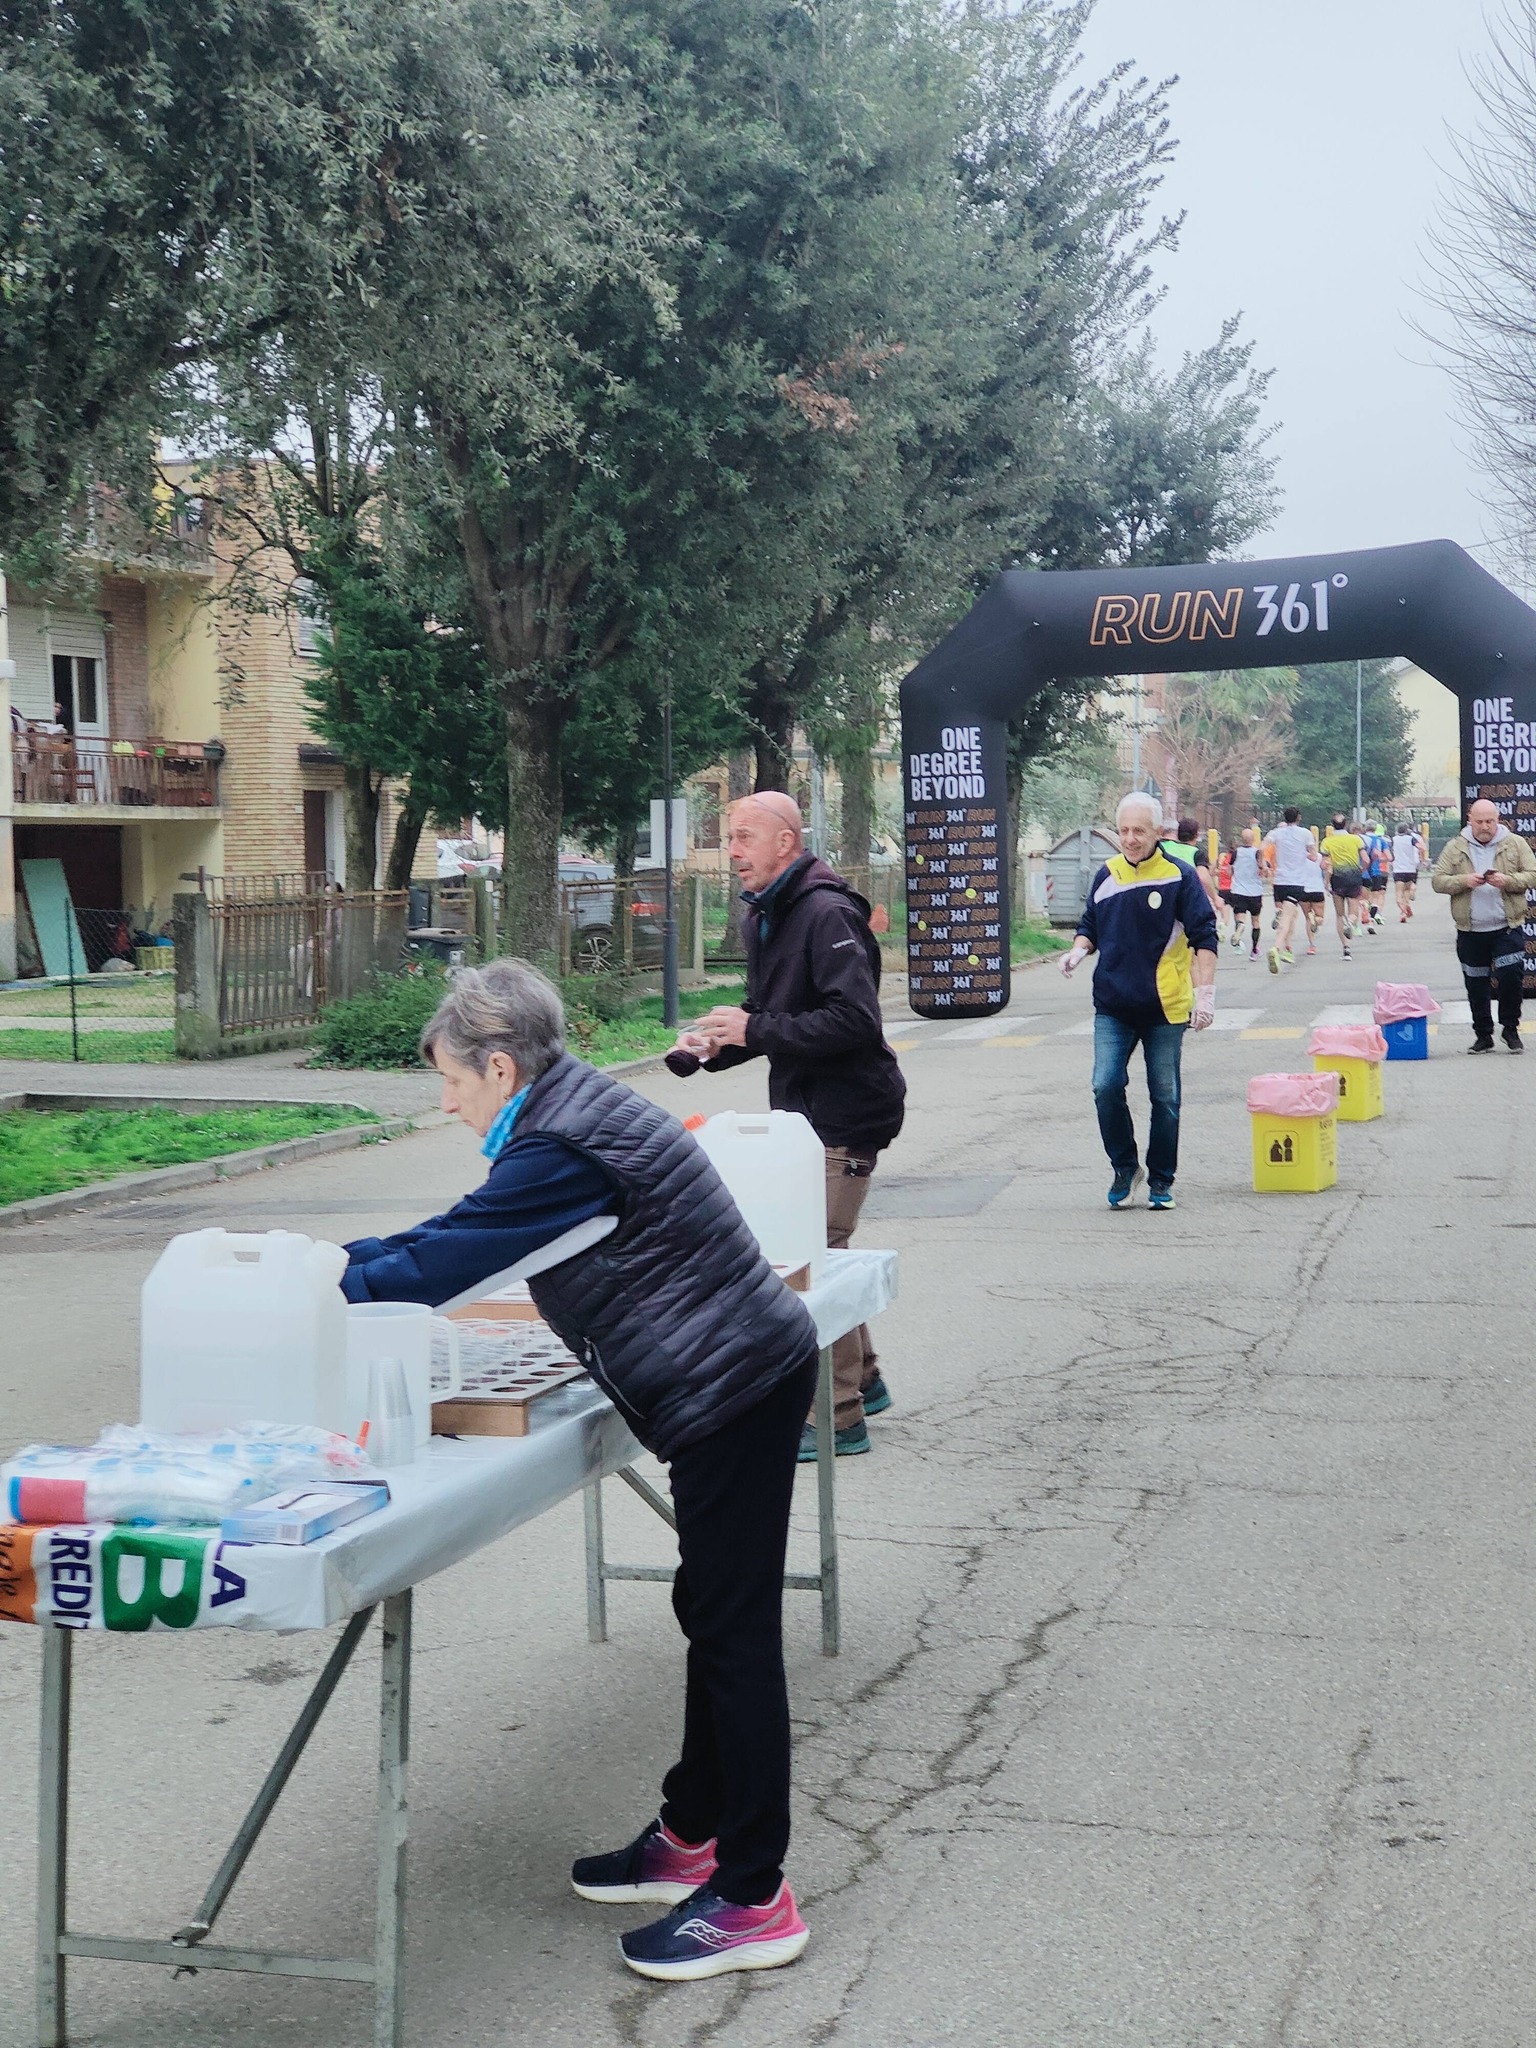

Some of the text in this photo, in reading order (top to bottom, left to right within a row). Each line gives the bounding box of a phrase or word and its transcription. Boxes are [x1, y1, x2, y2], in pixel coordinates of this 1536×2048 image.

[1089, 587, 1244, 646] RUN
[1473, 697, 1515, 723] ONE
[941, 727, 982, 751] ONE
[910, 751, 983, 777] DEGREE
[911, 775, 986, 802] BEYOND
